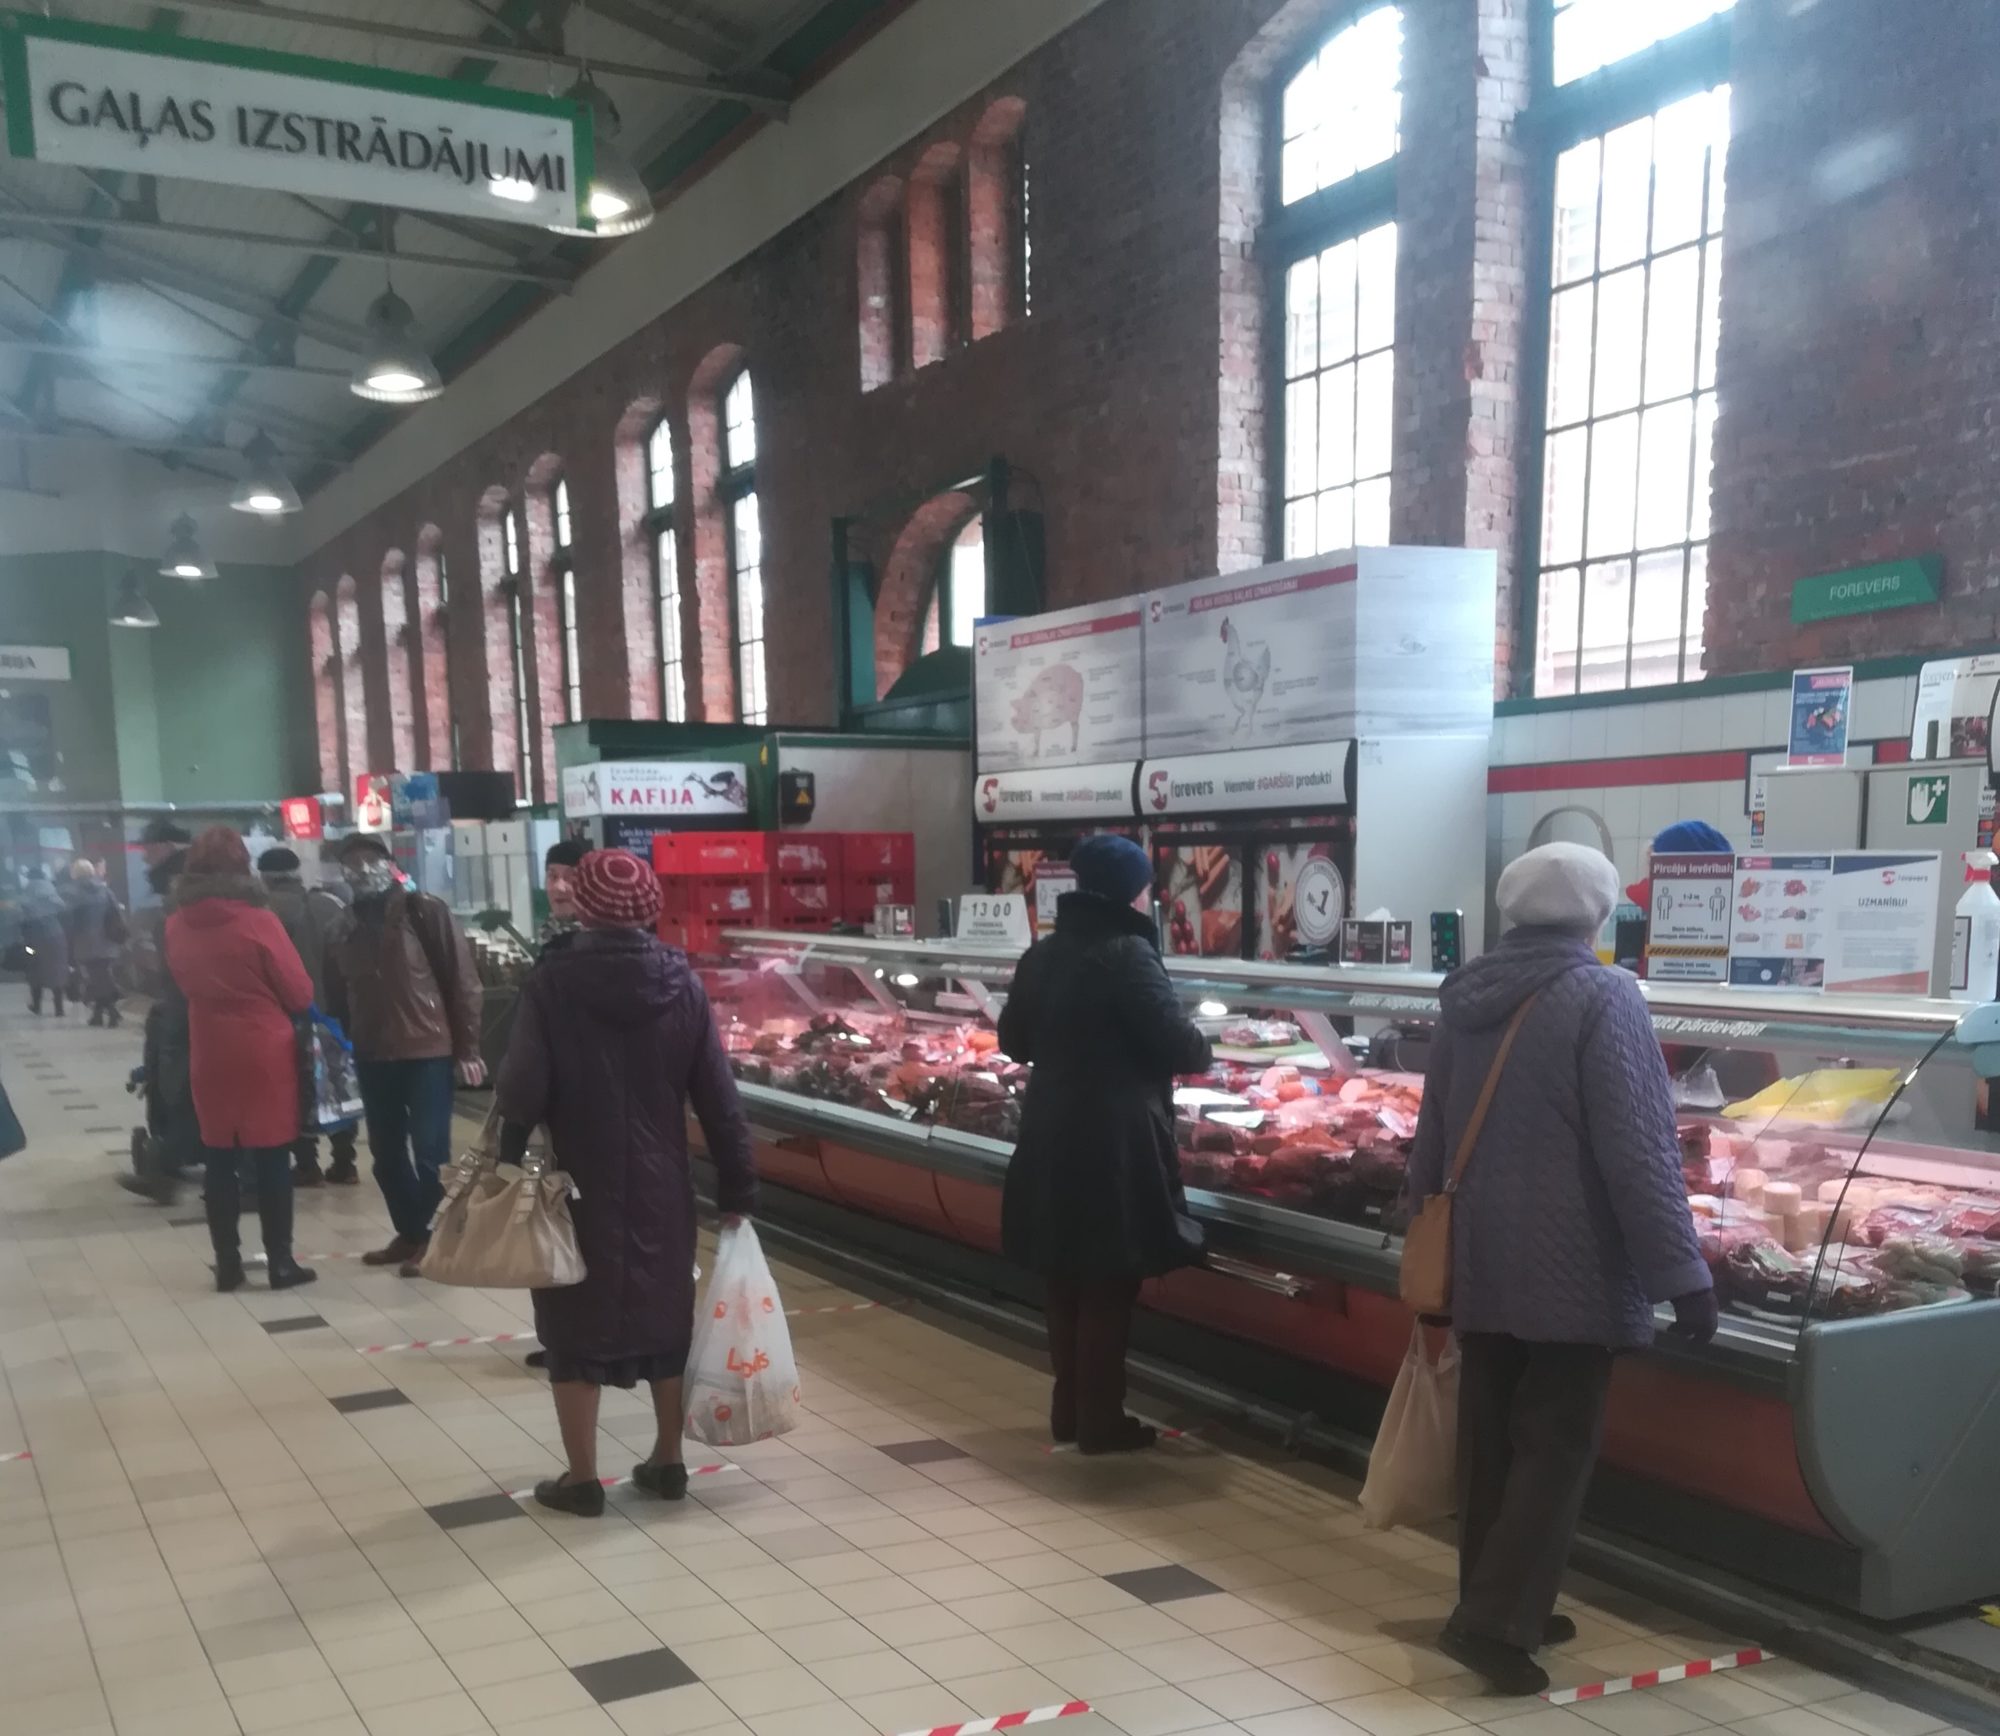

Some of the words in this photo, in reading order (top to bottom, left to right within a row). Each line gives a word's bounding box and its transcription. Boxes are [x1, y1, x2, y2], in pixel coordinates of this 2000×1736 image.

[49, 81, 216, 152] GAĻAS
[236, 105, 566, 193] IZSTRĀDĀJUMI
[1829, 575, 1901, 600] FOREVERS
[1170, 779, 1214, 799] forevers
[1295, 768, 1332, 790] produkti
[610, 788, 694, 805] KAFIJA
[1653, 863, 1686, 876] Pircēju
[1857, 896, 1909, 908] UZMANĪBU!
